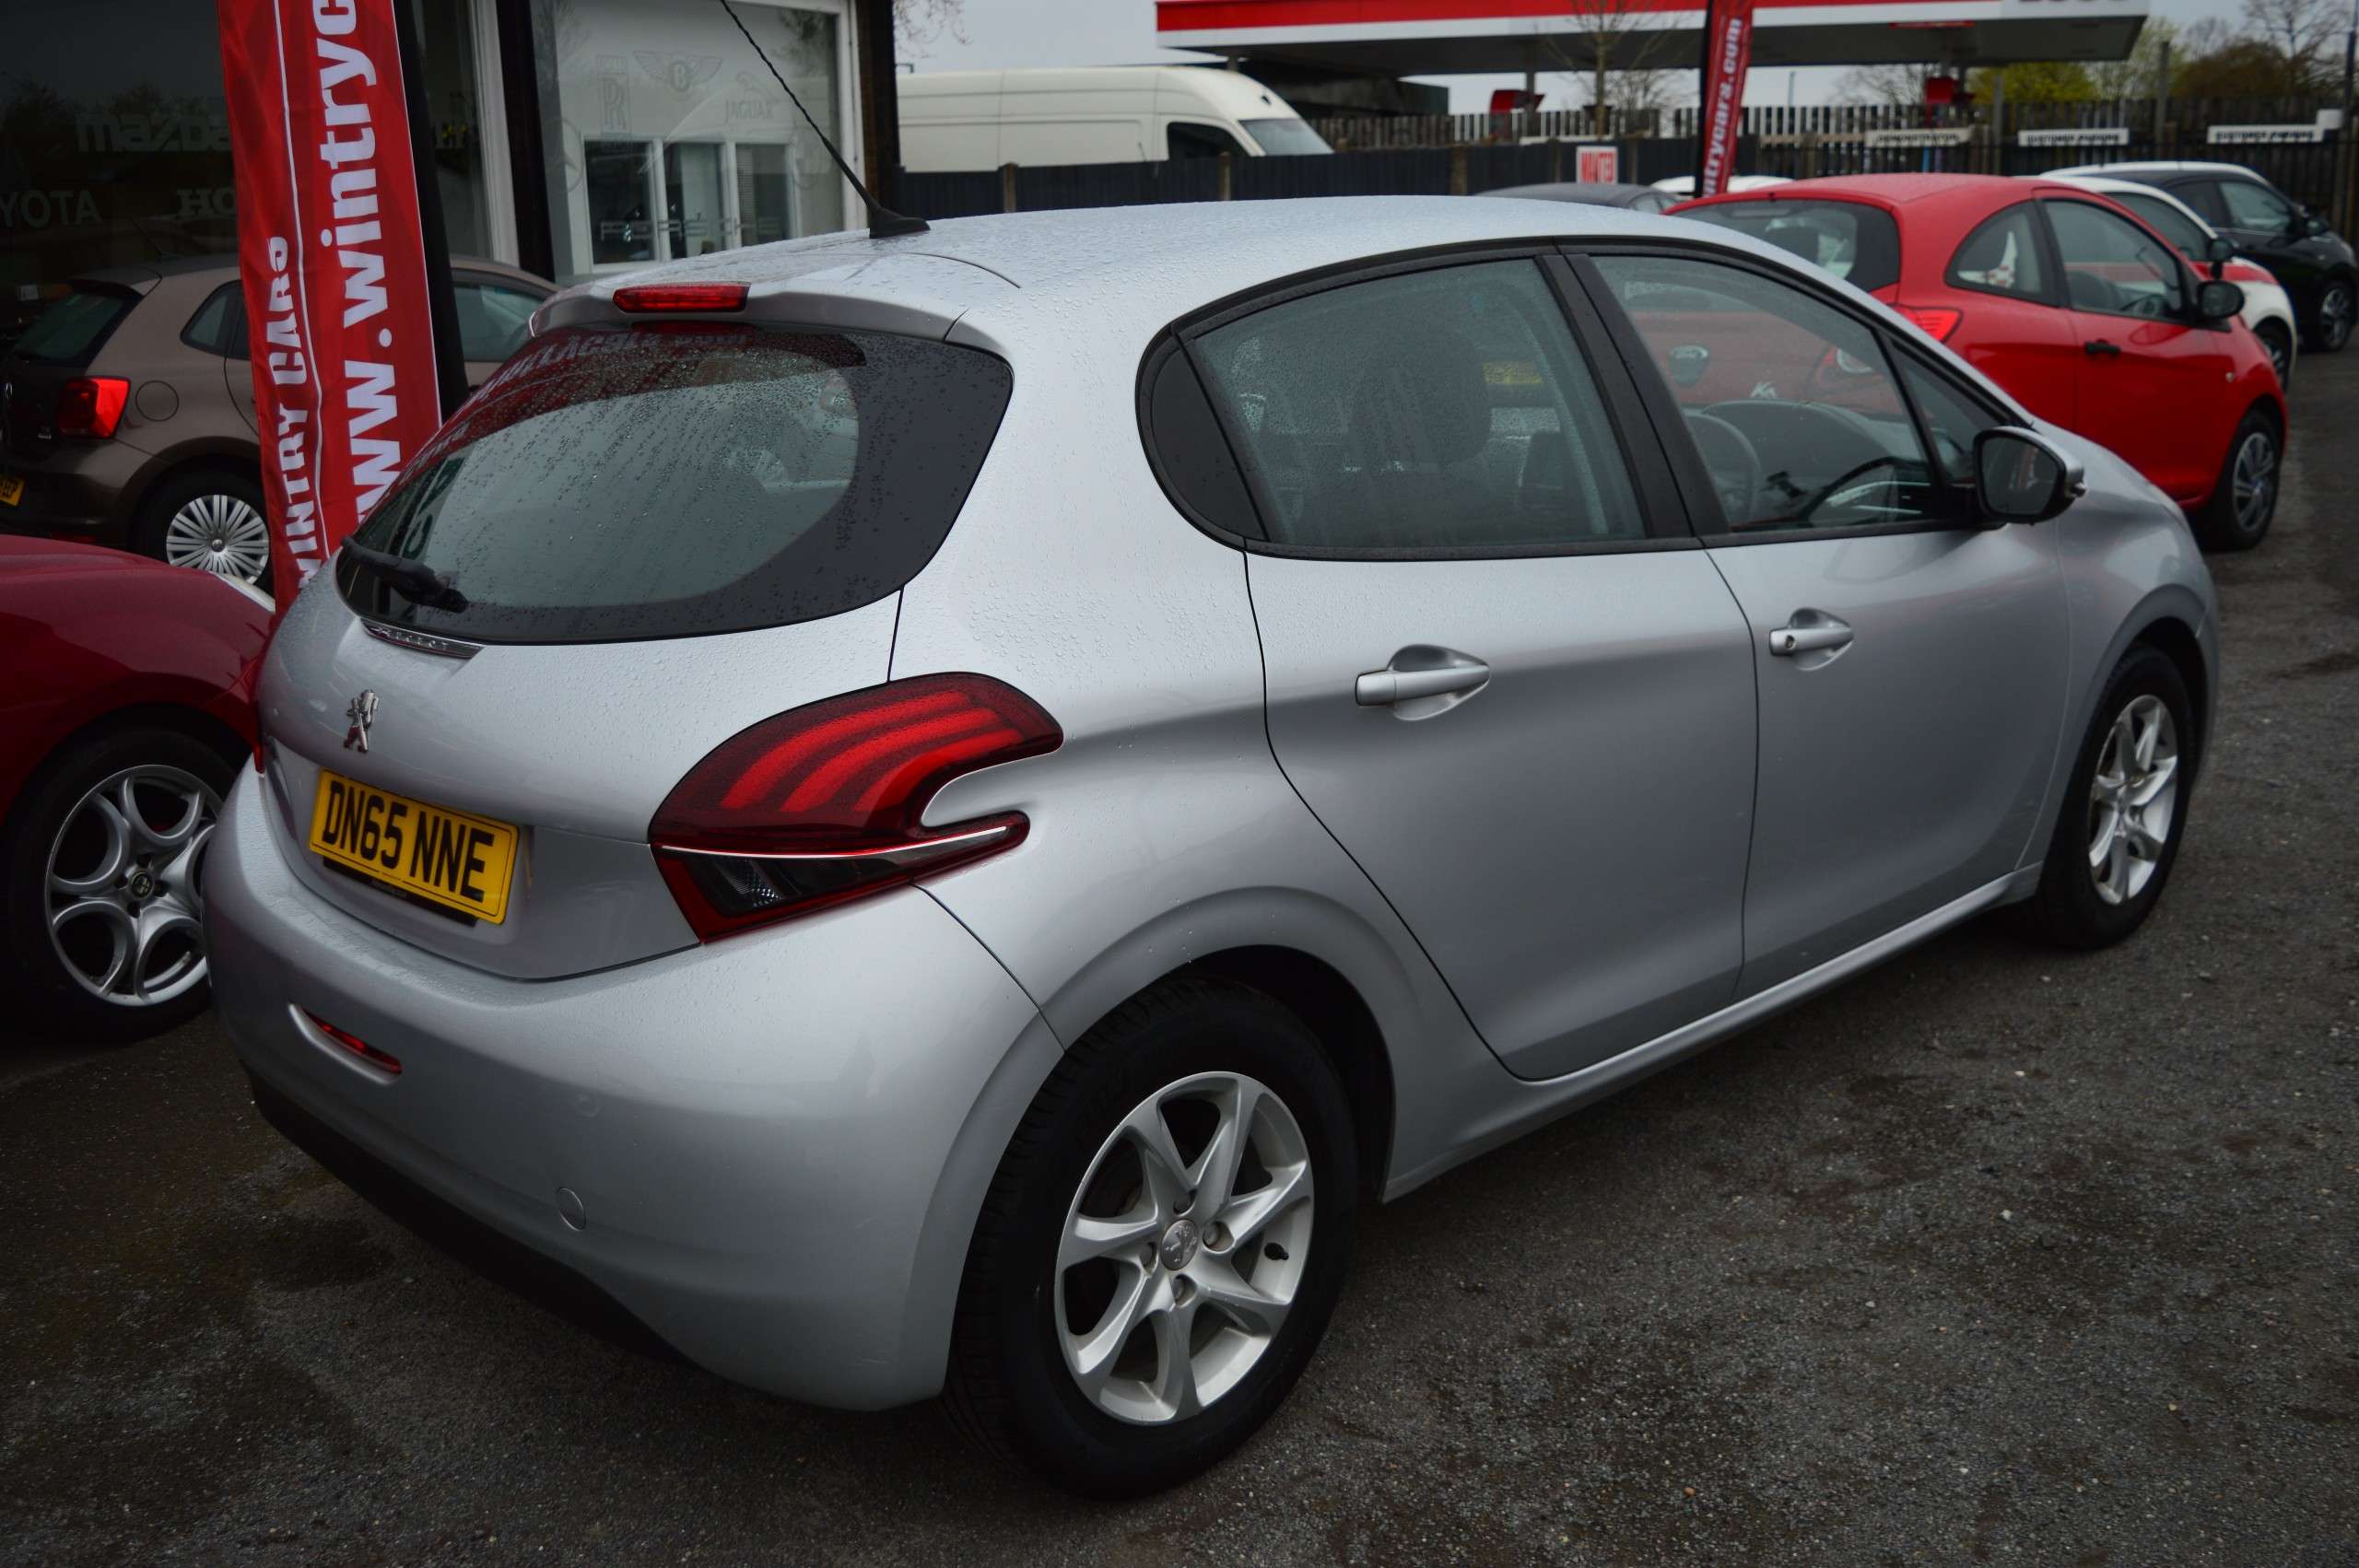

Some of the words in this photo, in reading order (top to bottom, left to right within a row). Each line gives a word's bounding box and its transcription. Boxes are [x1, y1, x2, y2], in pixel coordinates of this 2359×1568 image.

[725, 99, 774, 123] JAGUAR
[311, 0, 401, 525] ww.wintryc
[322, 779, 408, 870] DN65
[409, 810, 495, 904] NNE
